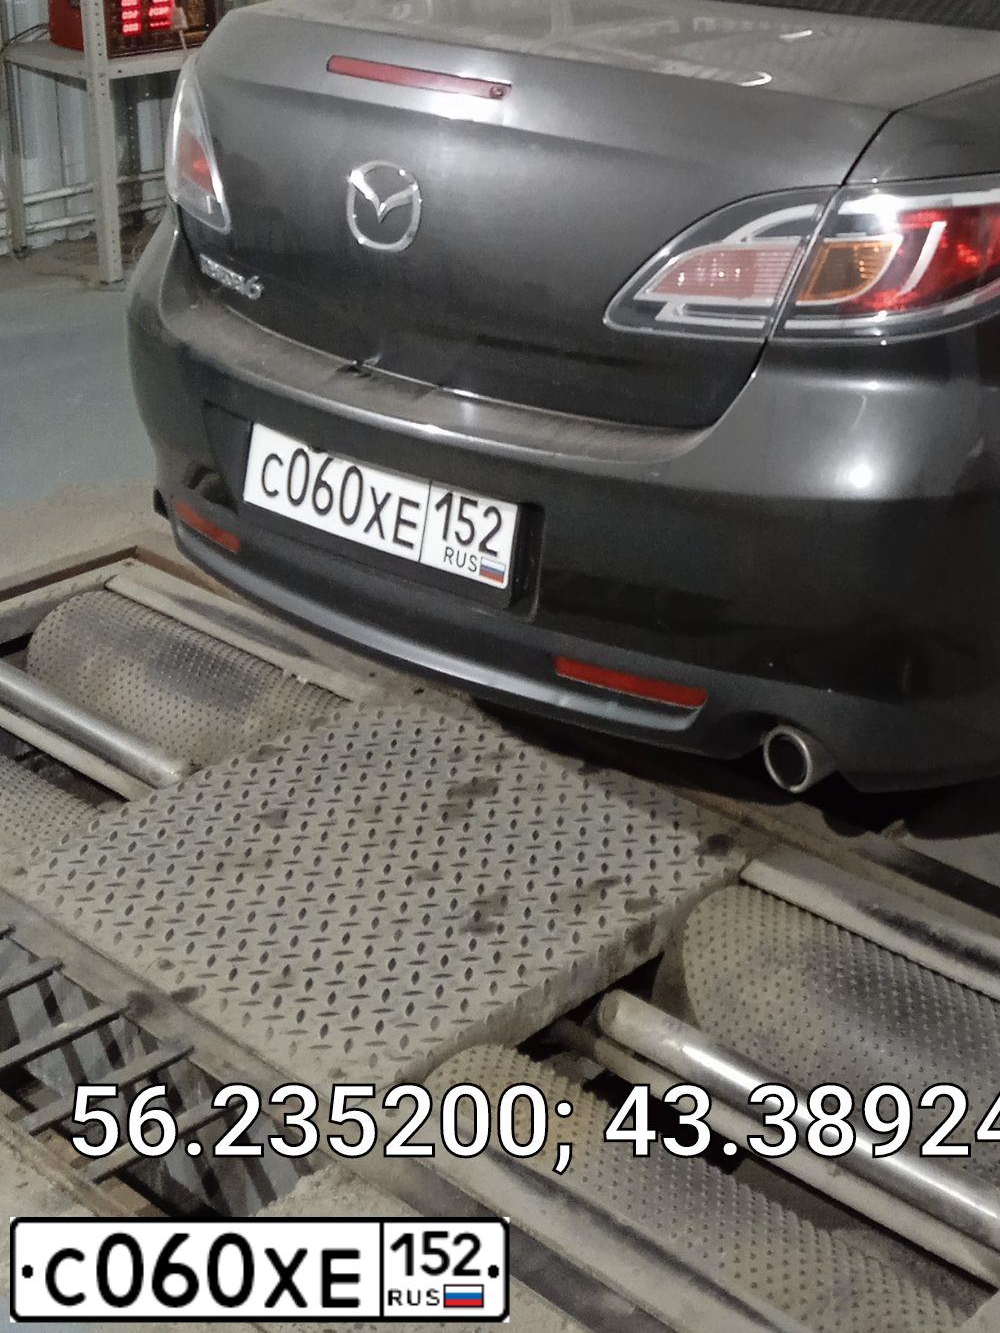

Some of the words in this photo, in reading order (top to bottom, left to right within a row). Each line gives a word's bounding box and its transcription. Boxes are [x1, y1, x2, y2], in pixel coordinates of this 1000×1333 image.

[261, 447, 421, 550] C060XE
[434, 492, 503, 558] 152
[443, 546, 478, 573] RUS
